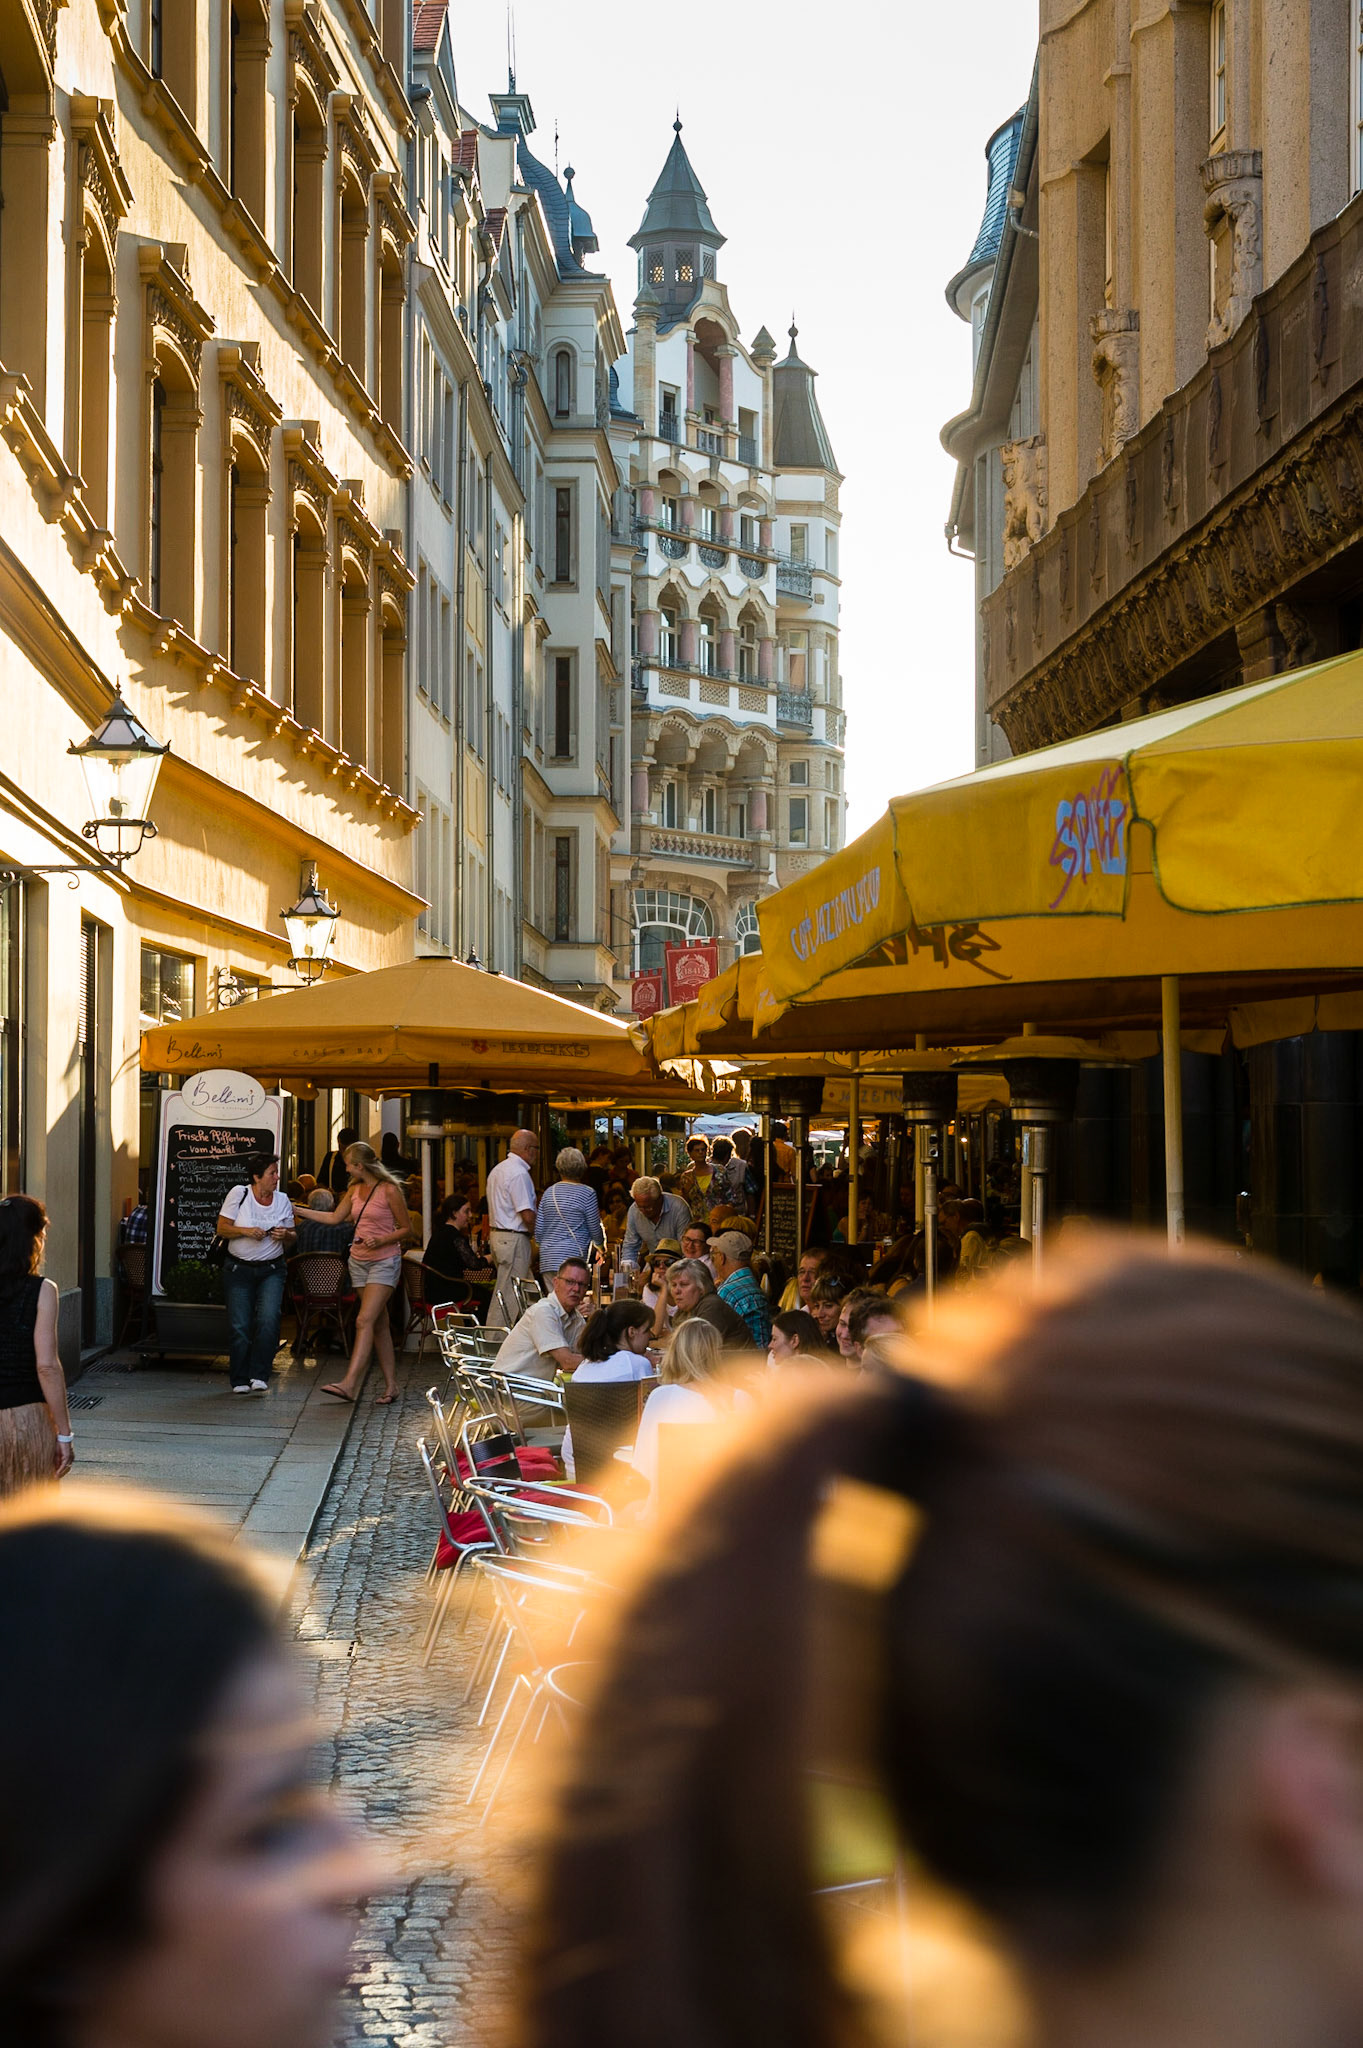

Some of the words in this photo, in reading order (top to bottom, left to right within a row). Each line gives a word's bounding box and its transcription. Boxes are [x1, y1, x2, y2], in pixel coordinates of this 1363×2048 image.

[684, 967, 701, 975] 1841
[167, 1035, 223, 1063] Bellini's
[191, 1076, 255, 1106] Bellini's
